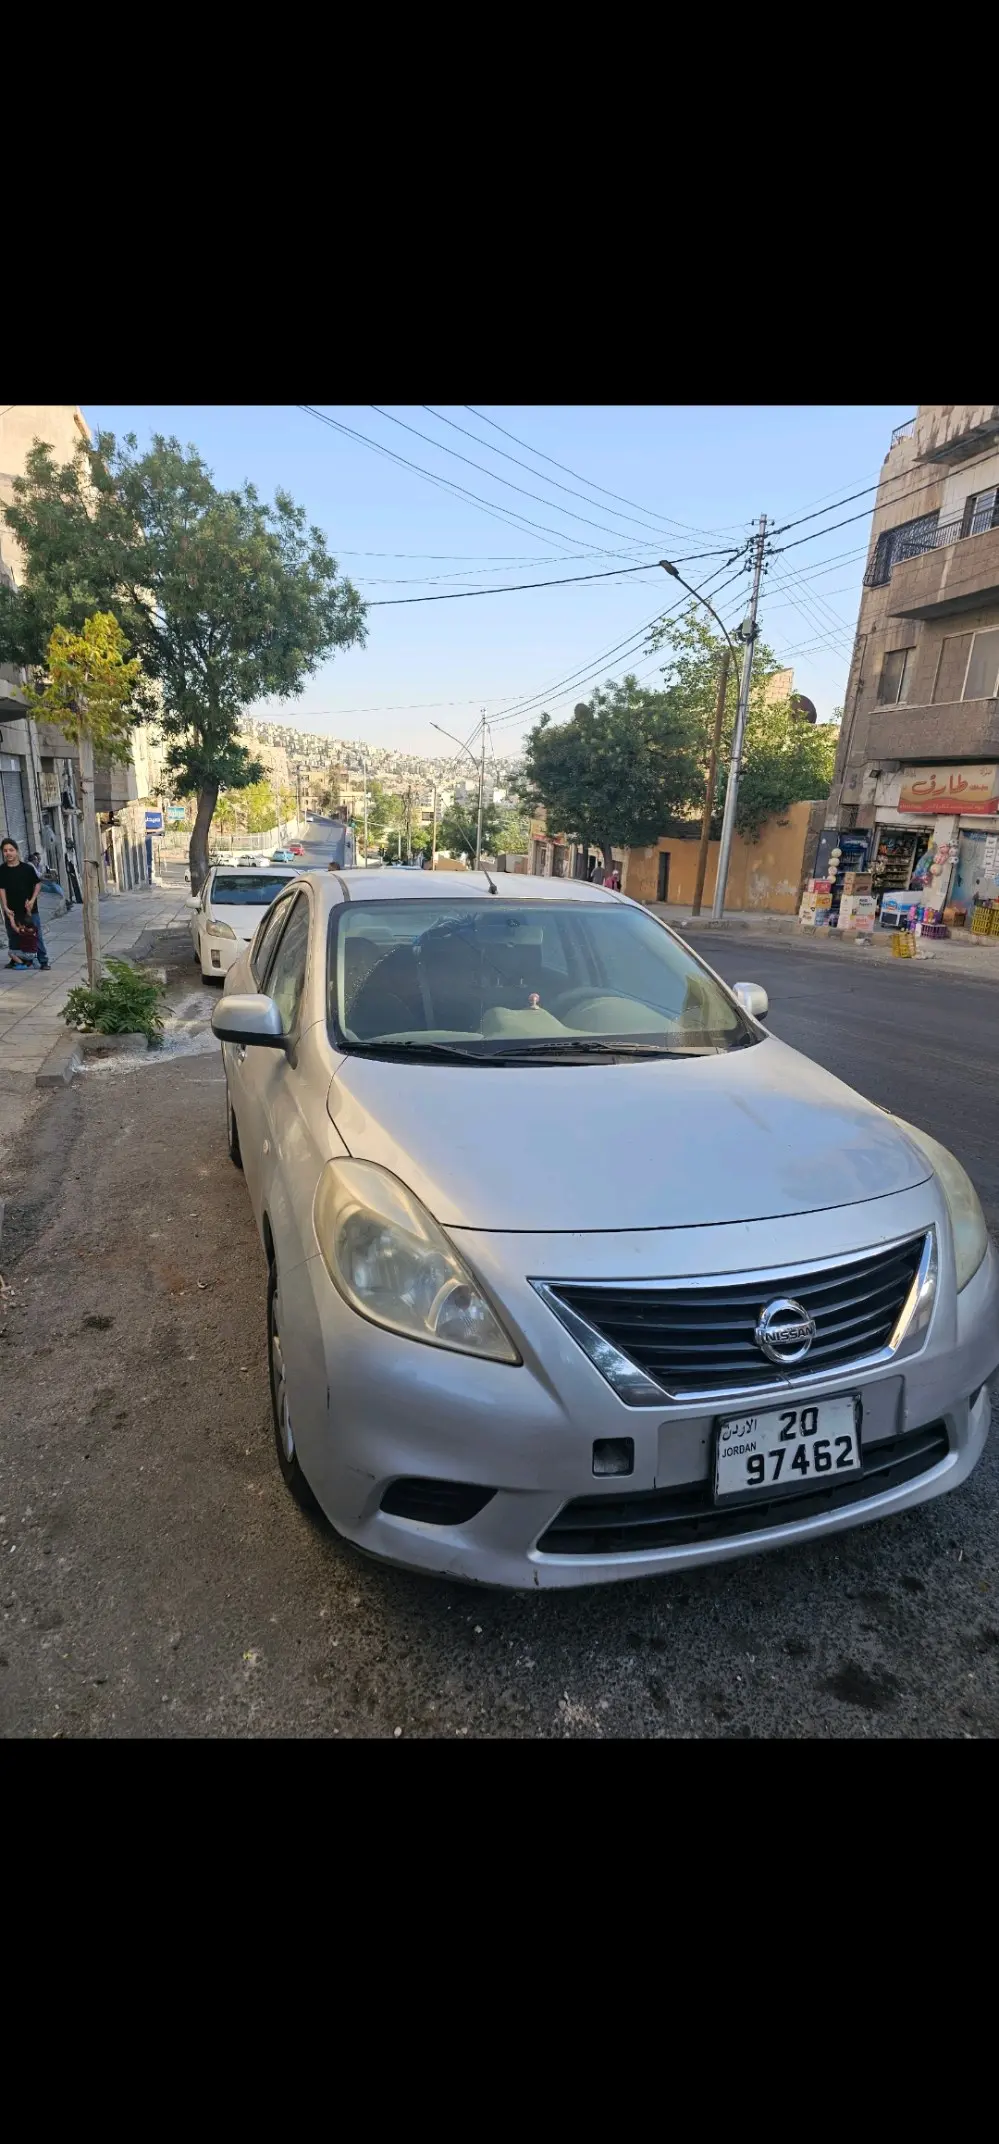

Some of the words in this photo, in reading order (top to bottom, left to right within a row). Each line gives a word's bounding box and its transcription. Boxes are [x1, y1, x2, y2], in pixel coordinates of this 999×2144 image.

[765, 1327, 813, 1341] NISSAN
[779, 1406, 819, 1442] 20
[722, 1442, 757, 1458] JORDAN
[746, 1435, 854, 1485] 97462
